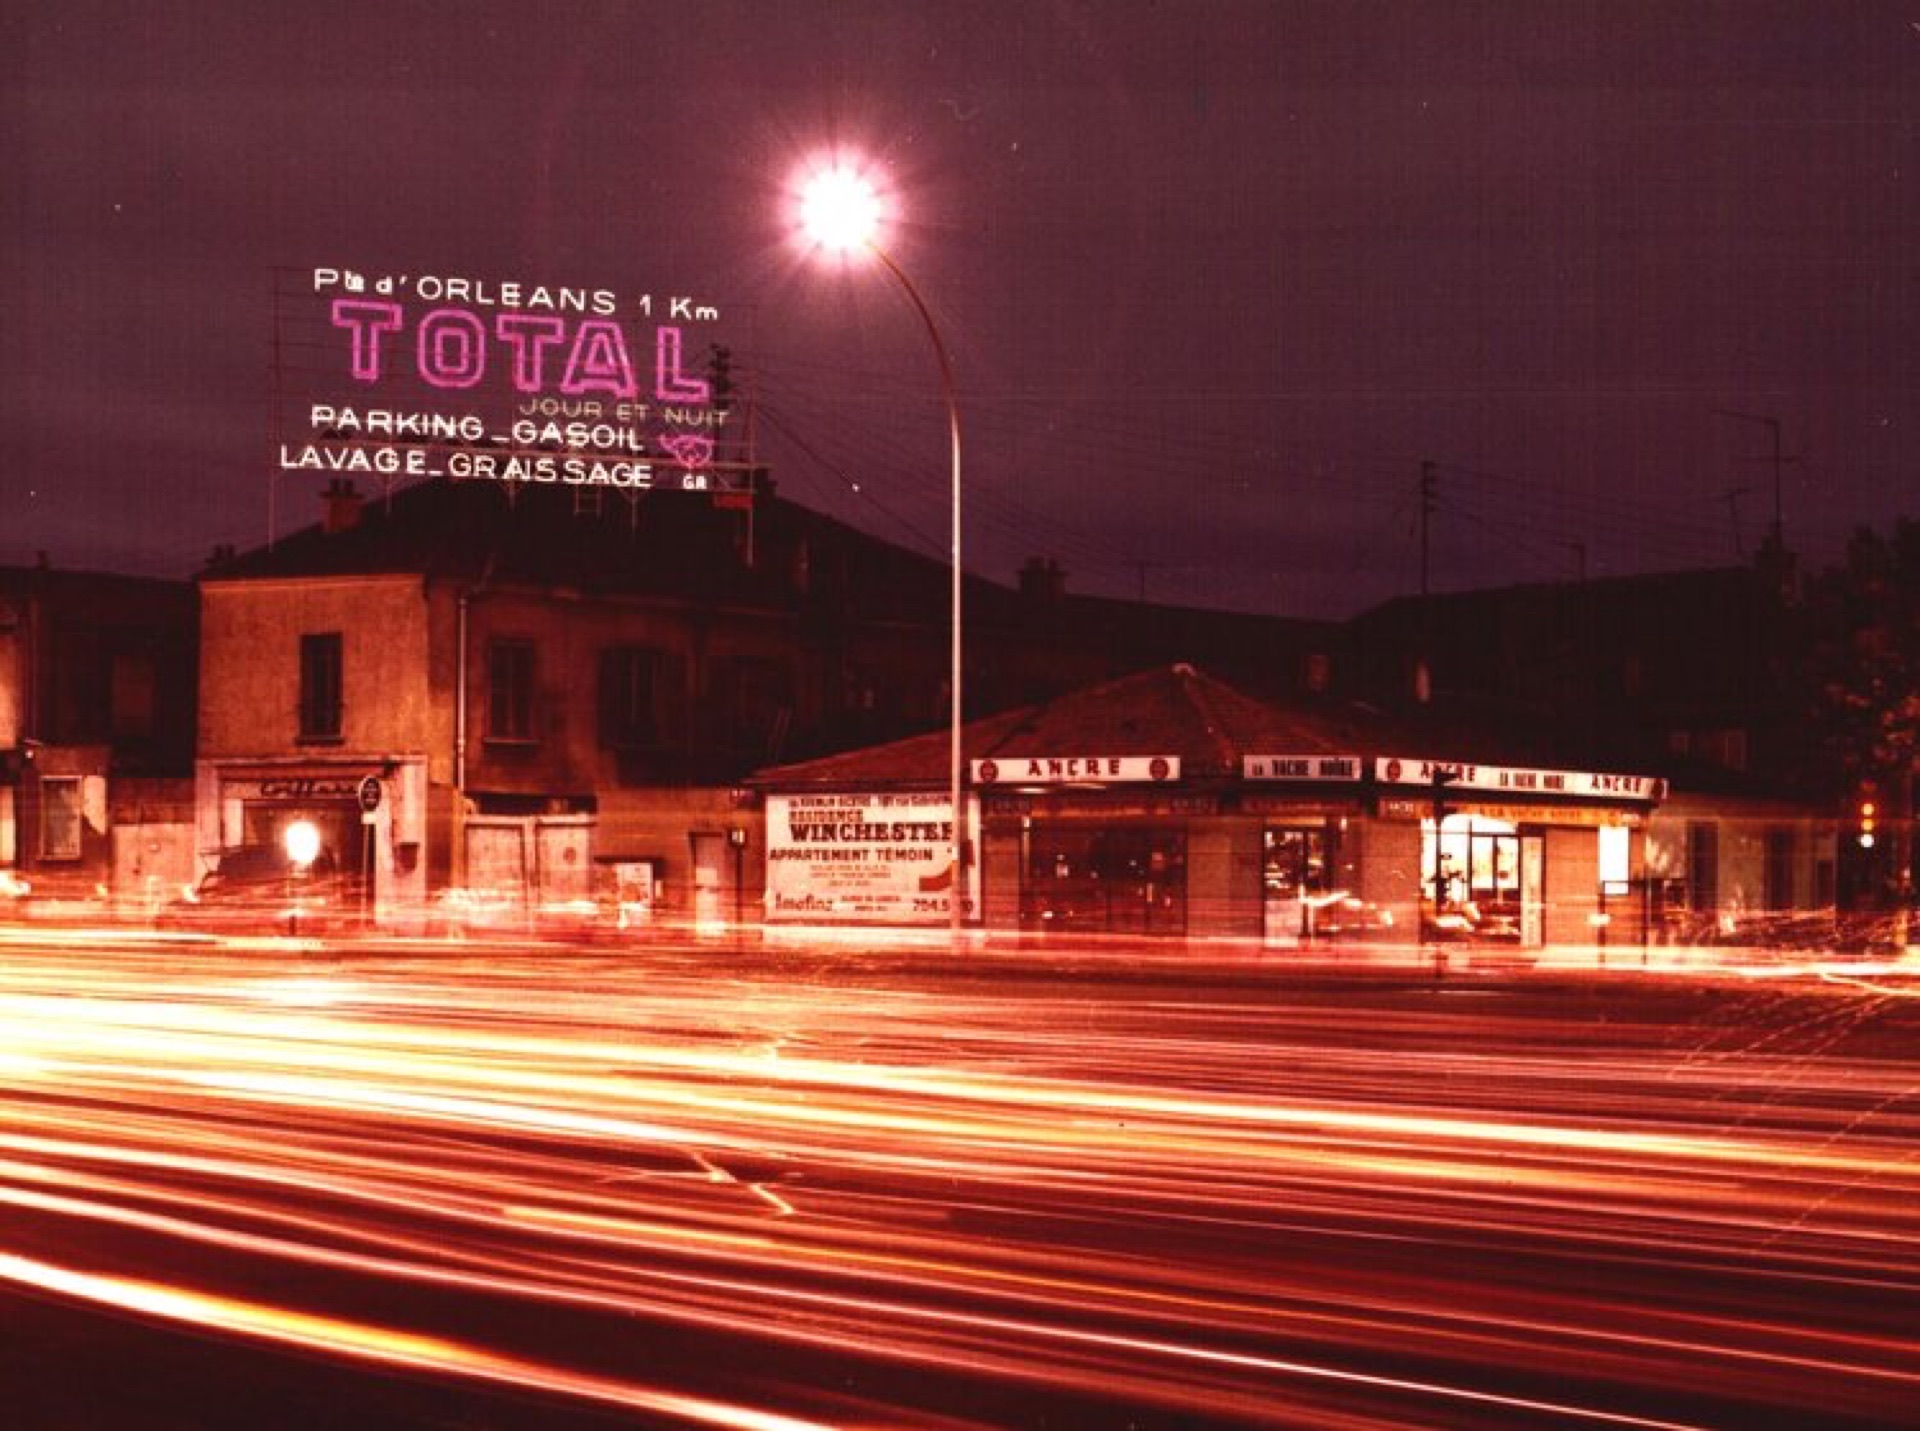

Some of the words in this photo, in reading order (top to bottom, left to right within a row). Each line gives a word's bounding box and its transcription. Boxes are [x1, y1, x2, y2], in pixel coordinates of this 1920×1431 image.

[640, 294, 652, 316] 1
[670, 298, 719, 321] Km
[331, 299, 710, 402] TOTAL
[519, 397, 602, 419] JOUR
[615, 403, 649, 422] ET
[664, 406, 730, 427] NUIT
[1027, 757, 1121, 777] ANCRE
[769, 848, 869, 861] APPARTEMENT
